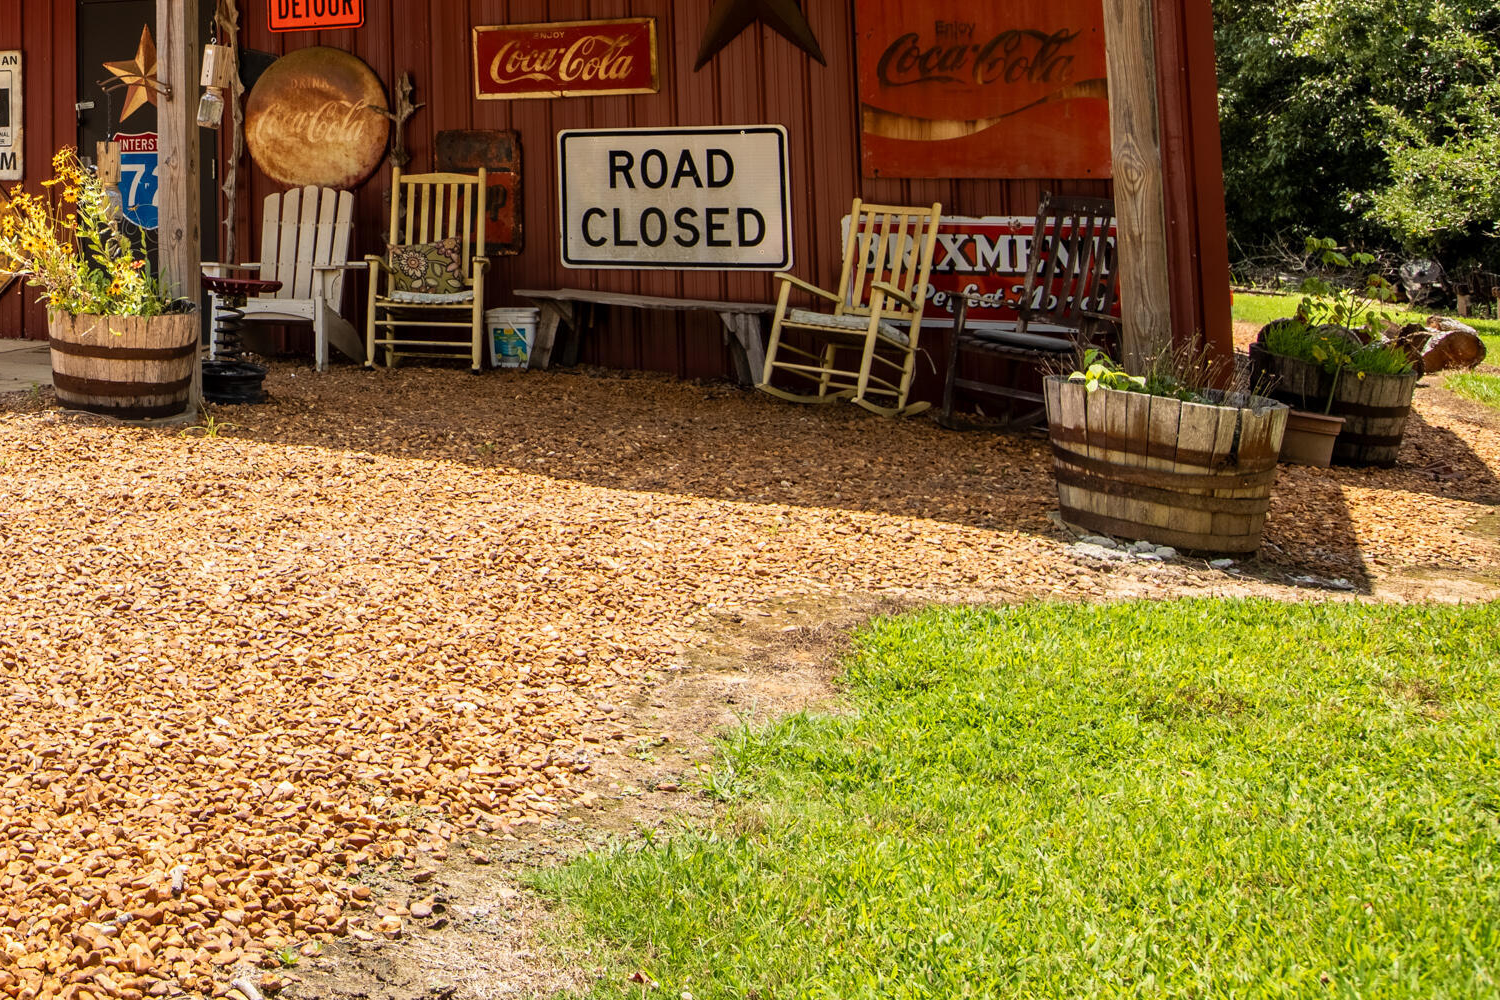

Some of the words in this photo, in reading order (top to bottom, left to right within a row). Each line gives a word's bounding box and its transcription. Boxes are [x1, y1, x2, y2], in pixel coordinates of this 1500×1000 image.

[532, 31, 565, 40] ENJOY
[935, 20, 976, 38] Enjoy
[2, 55, 18, 66] AN
[490, 34, 637, 84] Coca-Cola
[876, 27, 1083, 88] Coca-Cola
[290, 78, 330, 90] DRINK
[256, 98, 368, 145] Coca-Cola
[608, 148, 735, 189] ROAD
[581, 206, 766, 248] CLOSED
